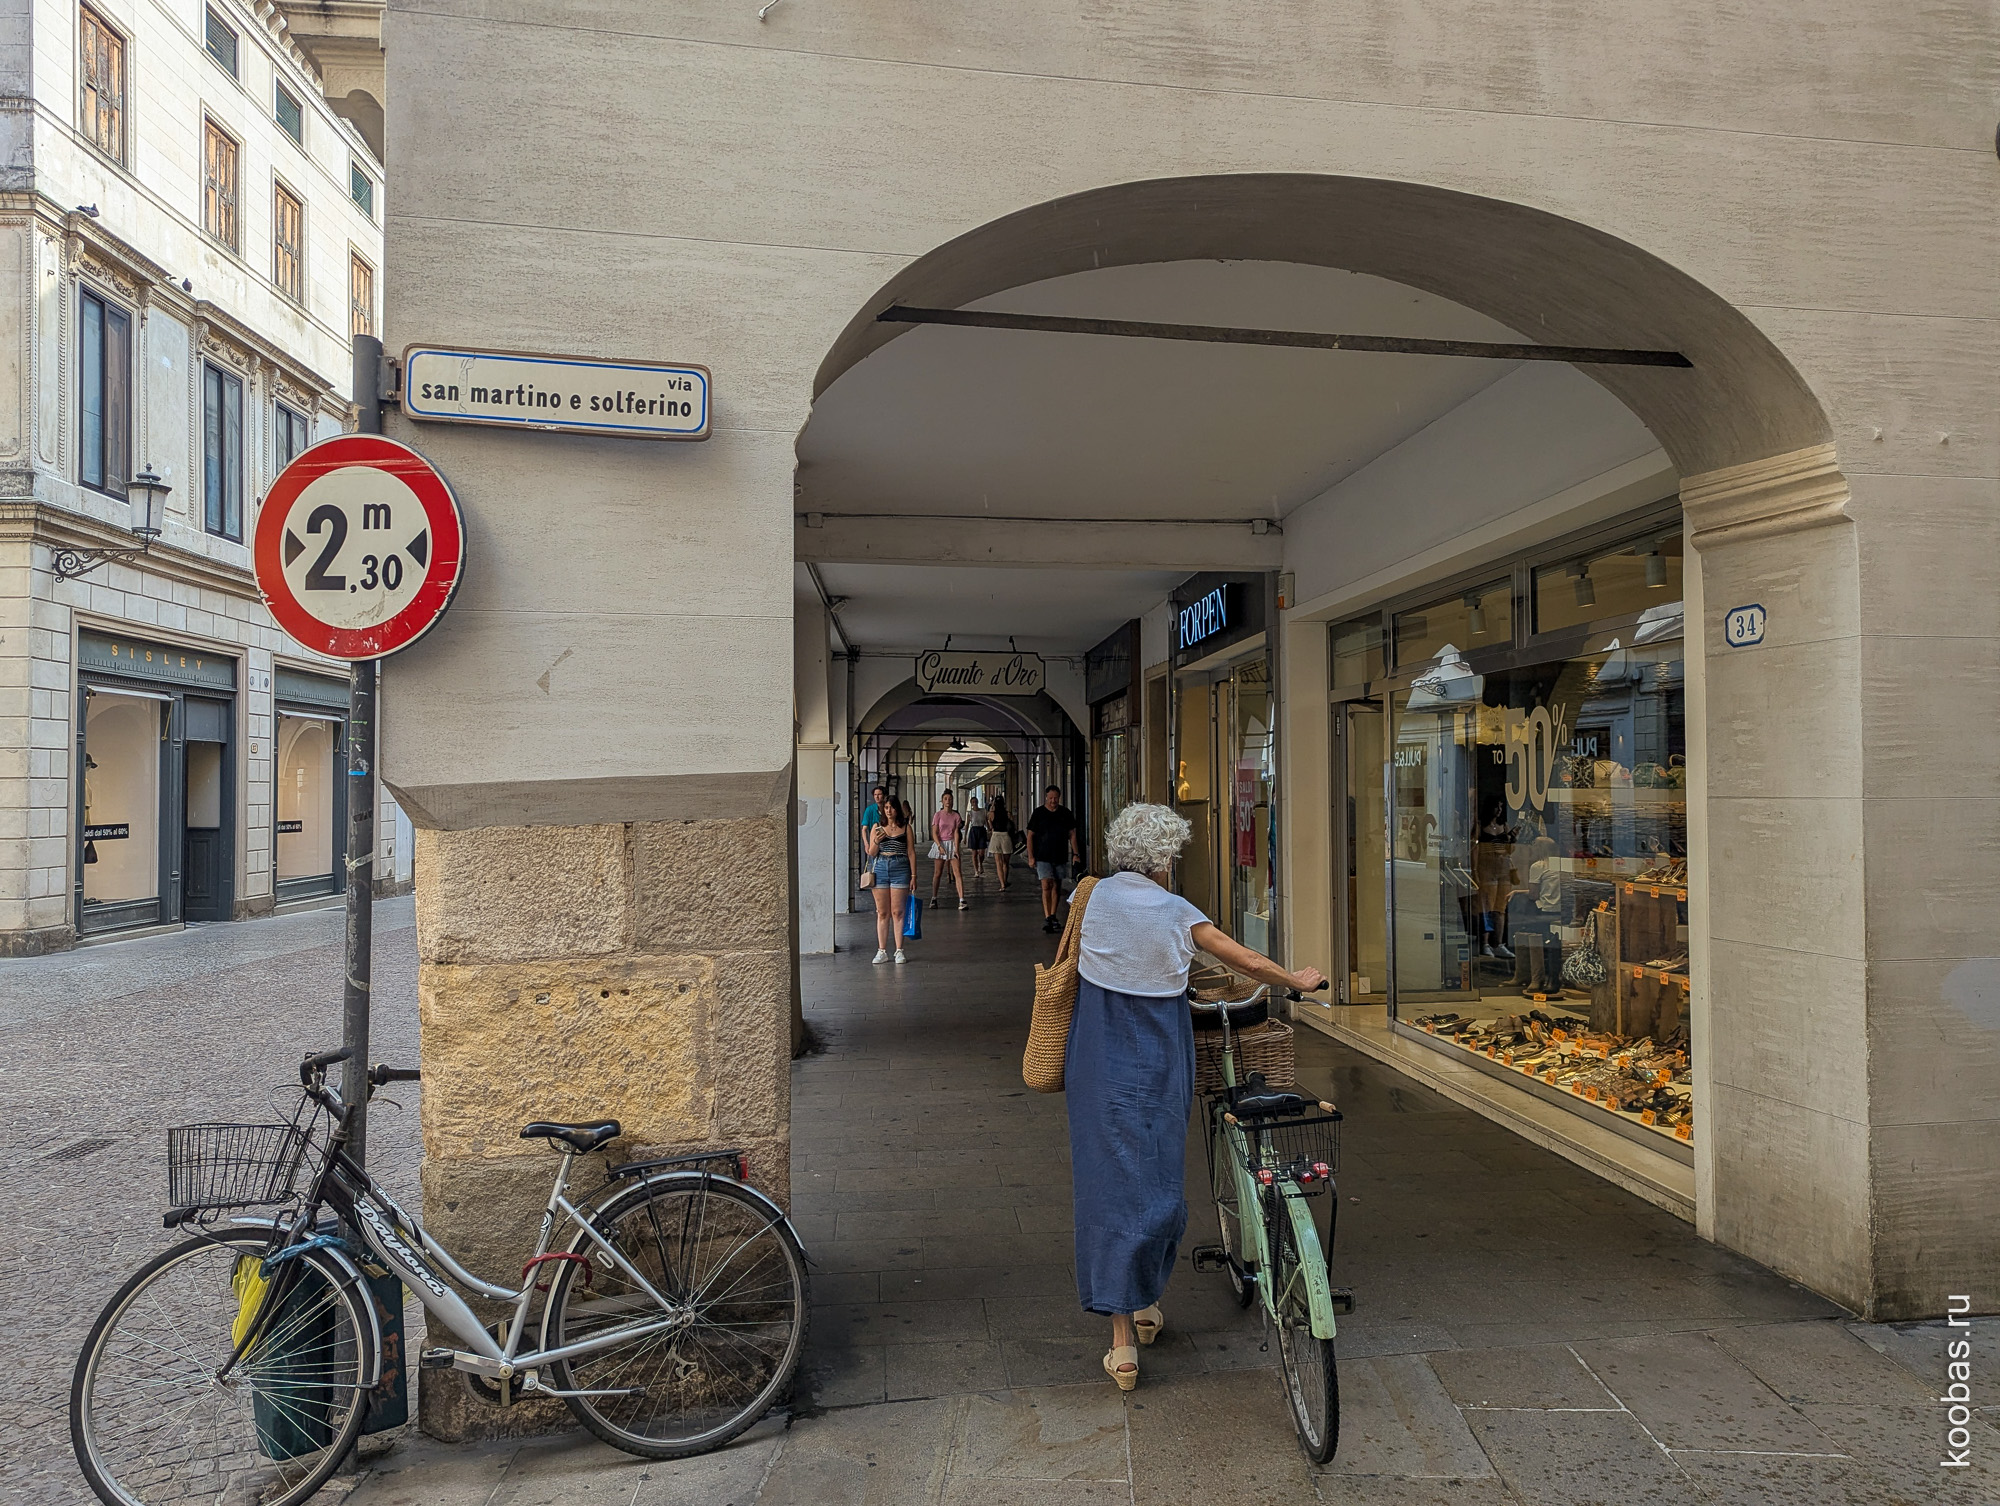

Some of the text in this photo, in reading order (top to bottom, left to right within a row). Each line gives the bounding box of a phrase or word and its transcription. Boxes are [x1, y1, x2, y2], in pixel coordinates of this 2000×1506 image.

[421, 382, 692, 418] san martino e solferino
[667, 377, 693, 392] via
[363, 503, 391, 530] m
[1179, 583, 1227, 650] FORPEN
[1736, 613, 1757, 638] 34
[111, 644, 202, 670] SISLEY
[922, 652, 984, 691] Guanto
[1492, 702, 1567, 811] TO 50%
[353, 1199, 445, 1297] Daytona
